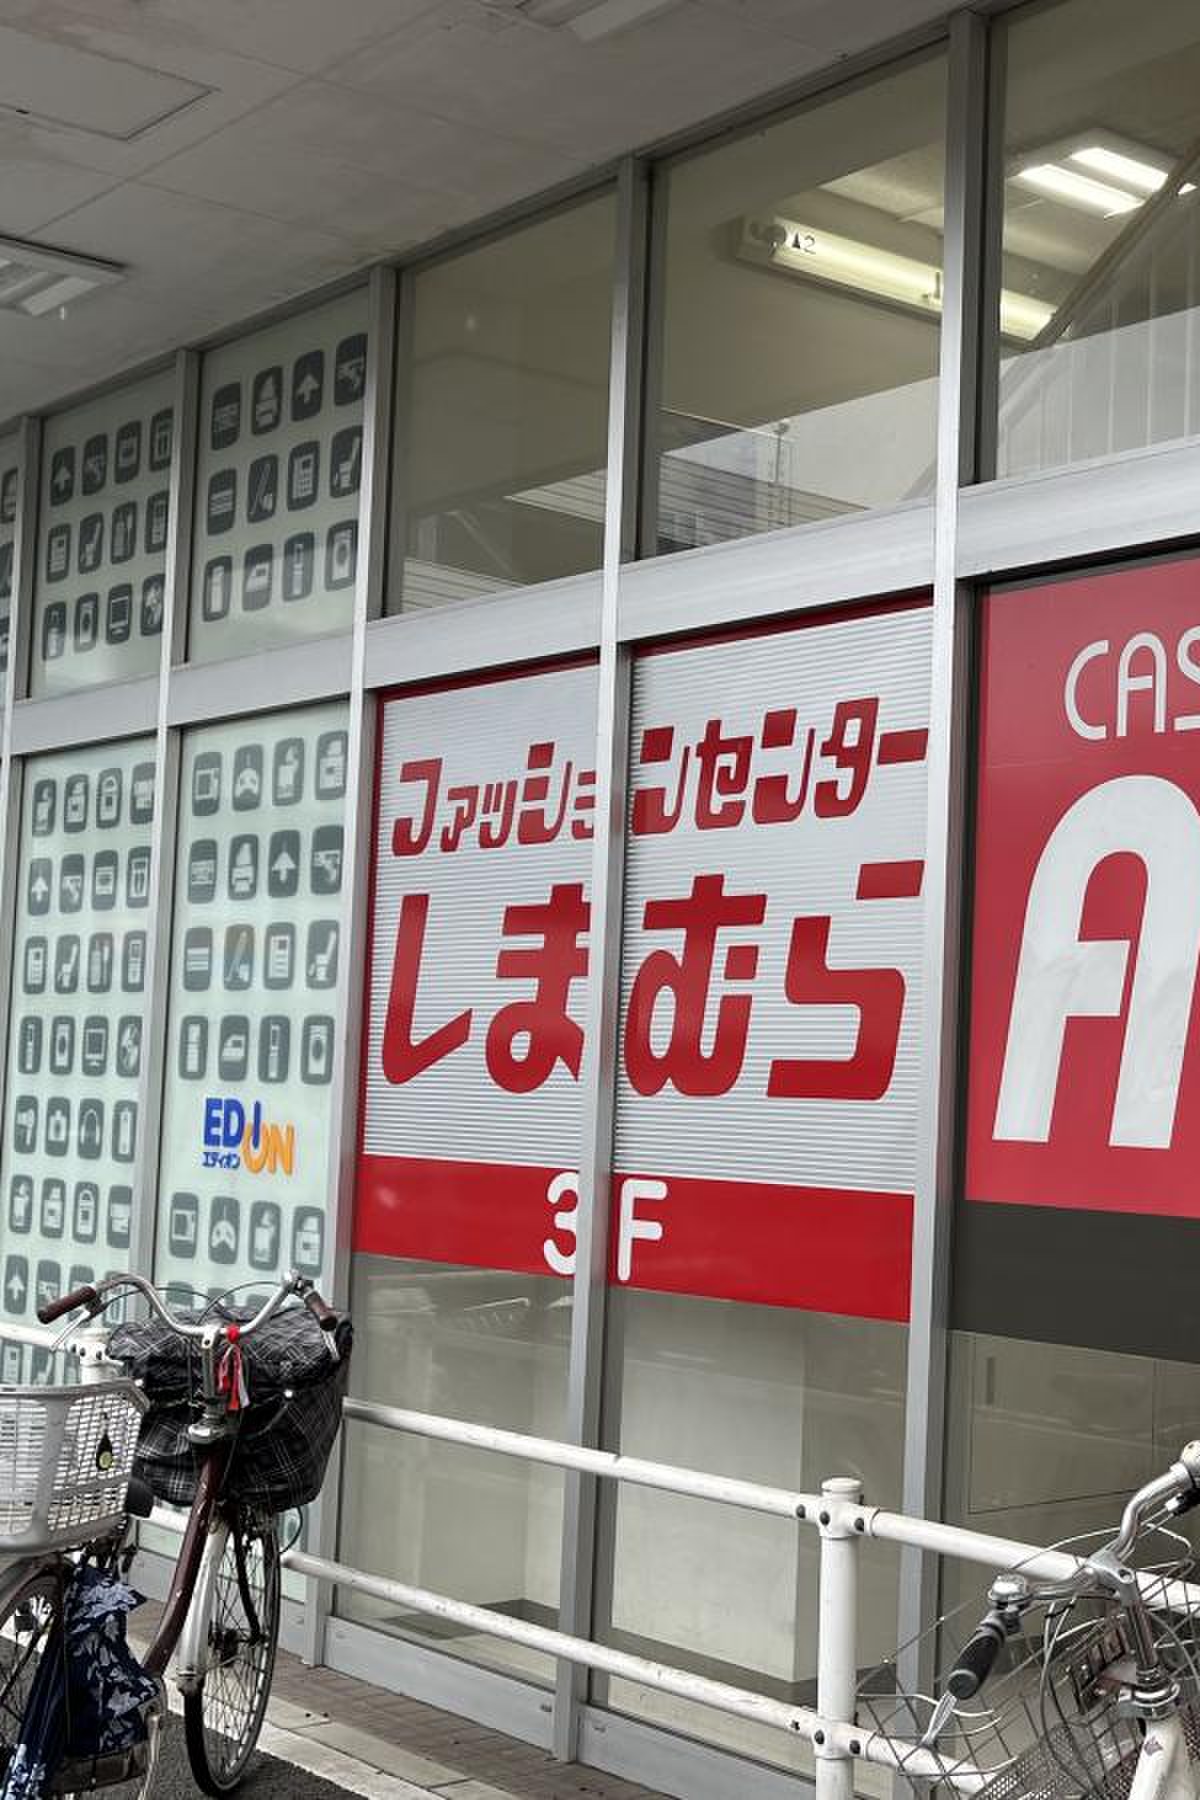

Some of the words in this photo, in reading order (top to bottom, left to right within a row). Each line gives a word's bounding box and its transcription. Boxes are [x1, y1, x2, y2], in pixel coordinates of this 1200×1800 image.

[381, 859, 926, 1102] しまむら
[204, 1098, 294, 1175] EDION
